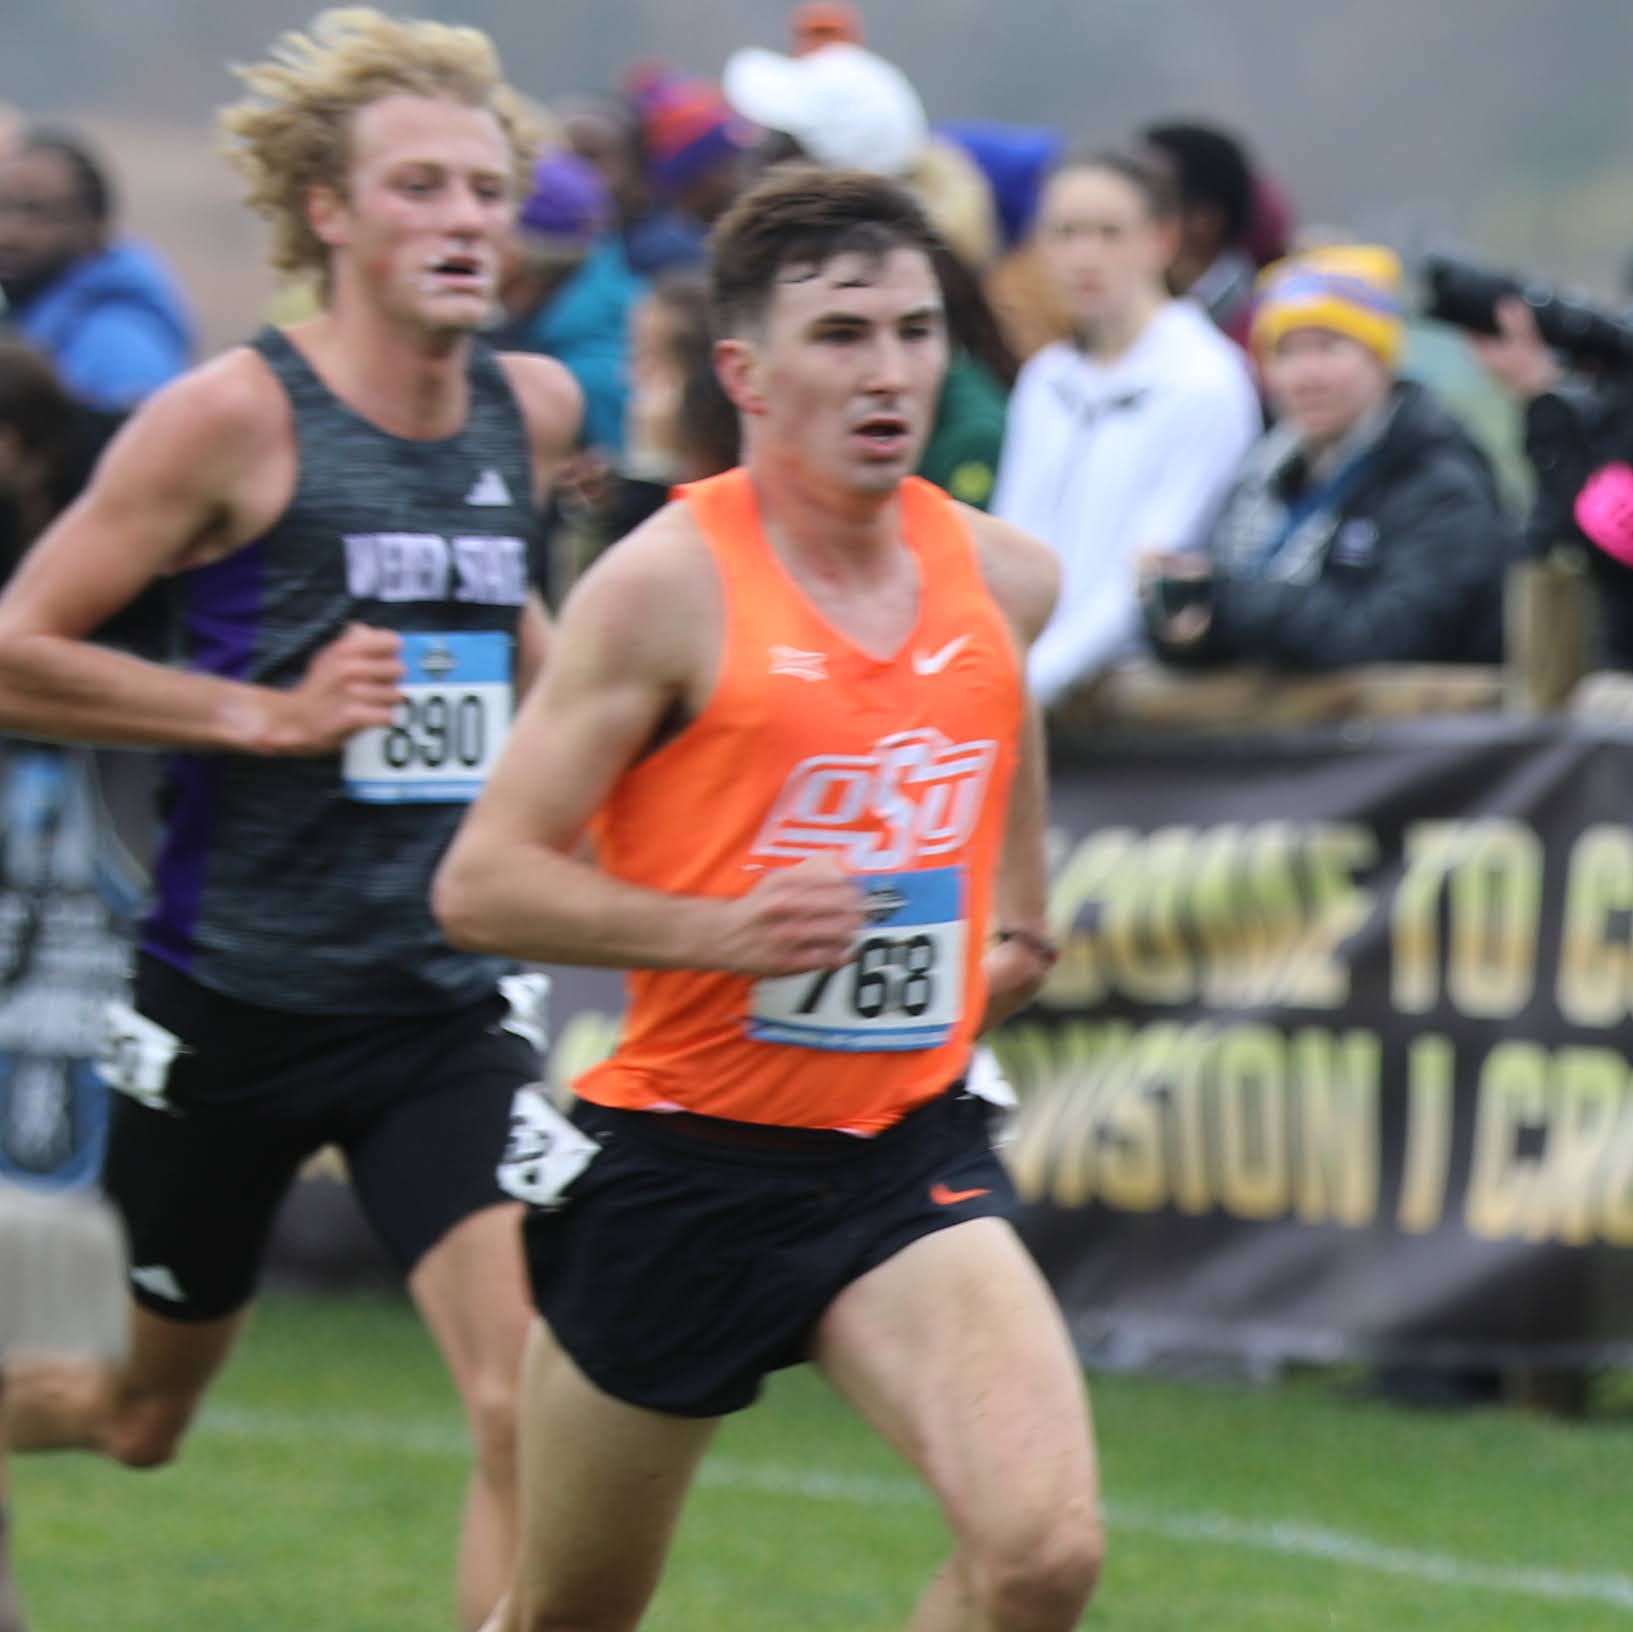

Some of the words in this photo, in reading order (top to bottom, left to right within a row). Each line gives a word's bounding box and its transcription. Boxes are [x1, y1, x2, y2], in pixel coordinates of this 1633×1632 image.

[382, 693, 486, 769] 890
[750, 727, 998, 871] OSU
[793, 934, 937, 1020] 768
[1392, 818, 1545, 1016] TO
[1400, 1033, 1455, 1234] I
